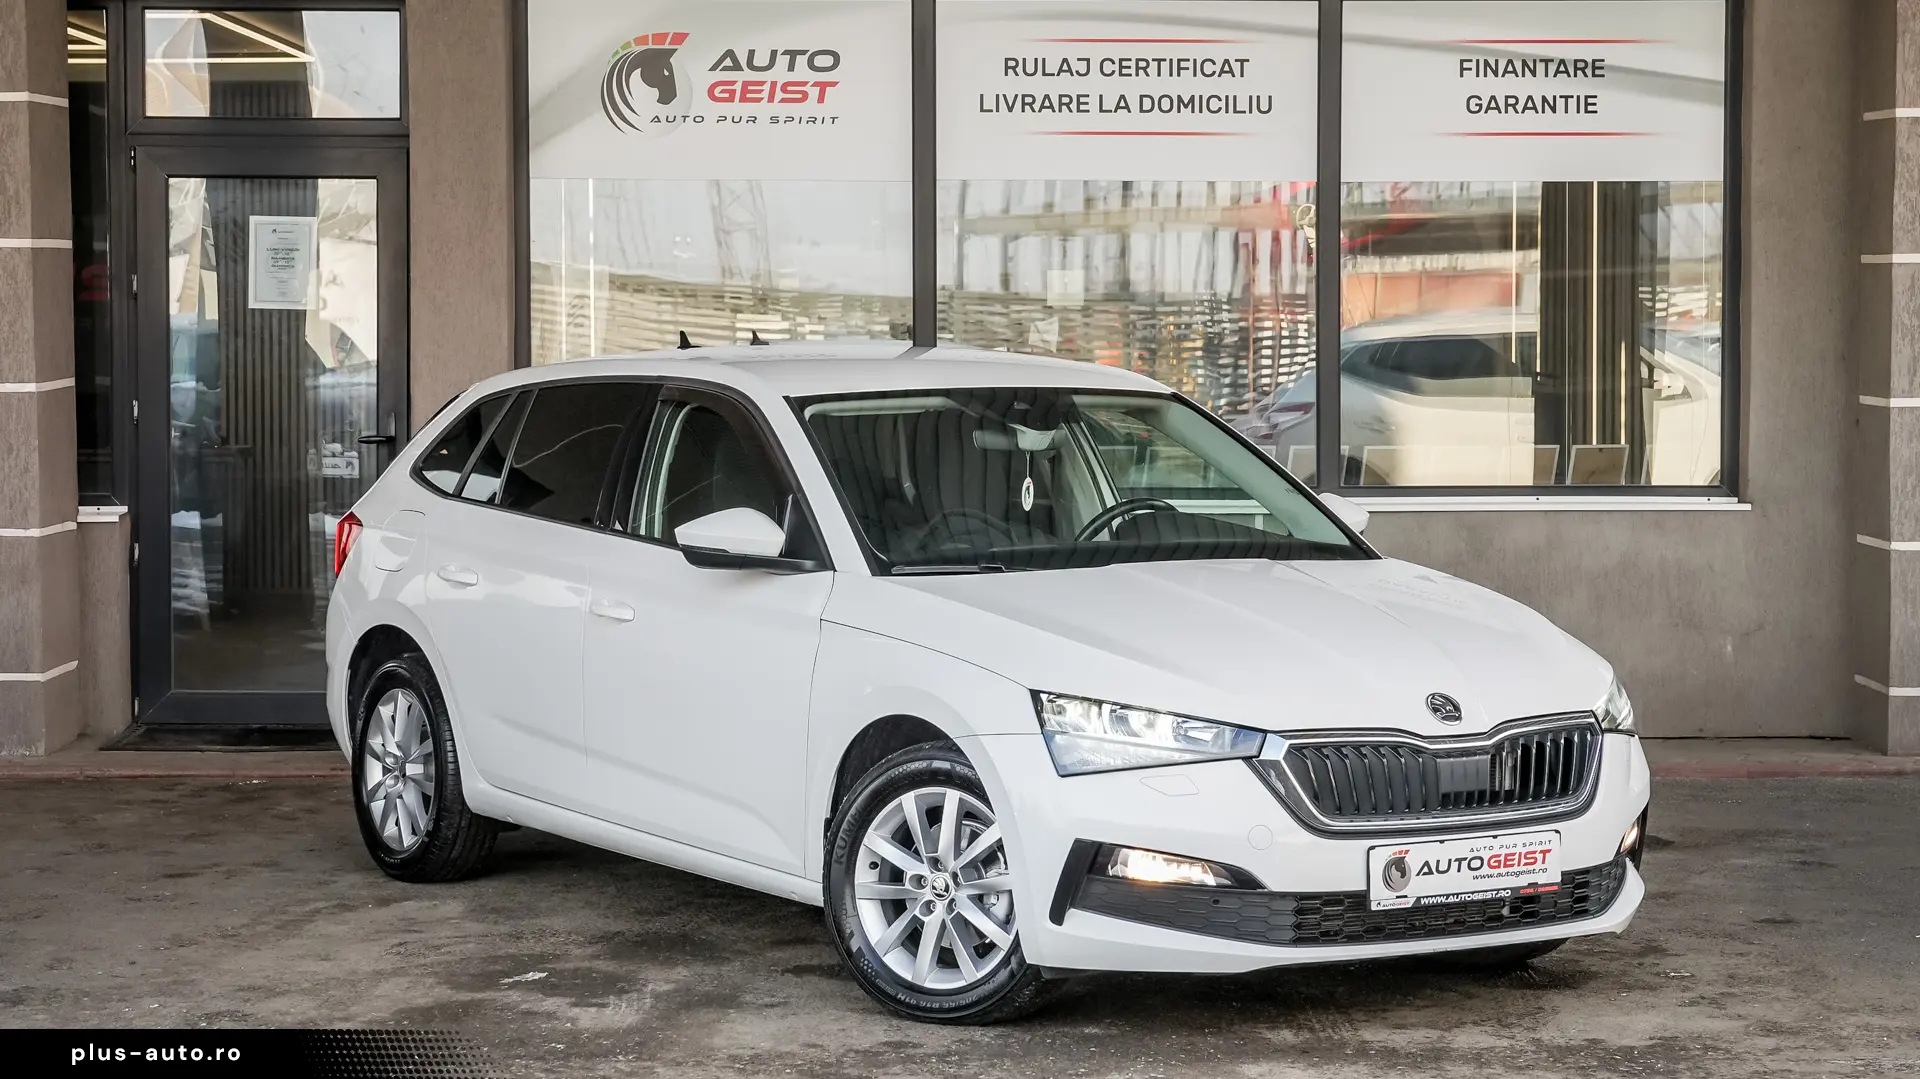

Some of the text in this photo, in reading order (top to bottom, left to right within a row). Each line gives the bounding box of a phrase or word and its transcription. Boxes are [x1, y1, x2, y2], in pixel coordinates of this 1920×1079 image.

[708, 49, 841, 73] AUTO
[1004, 57, 1250, 78] RULAJ CERTIFICAT
[1459, 58, 1606, 78] FINANTARE
[706, 80, 841, 104] GEIST
[979, 93, 1273, 115] LIVRARE LA DOMICILIU
[1466, 94, 1598, 115] GARANTIE
[649, 114, 840, 125] AUTO PUR SPIRIT
[1469, 839, 1553, 853] AUTO PUR SPIRIT
[1415, 848, 1553, 877] AUTOGEIST
[1472, 868, 1548, 881] www.autogeist.ro
[1420, 889, 1512, 905] WWW.AUTOGEIST.RO
